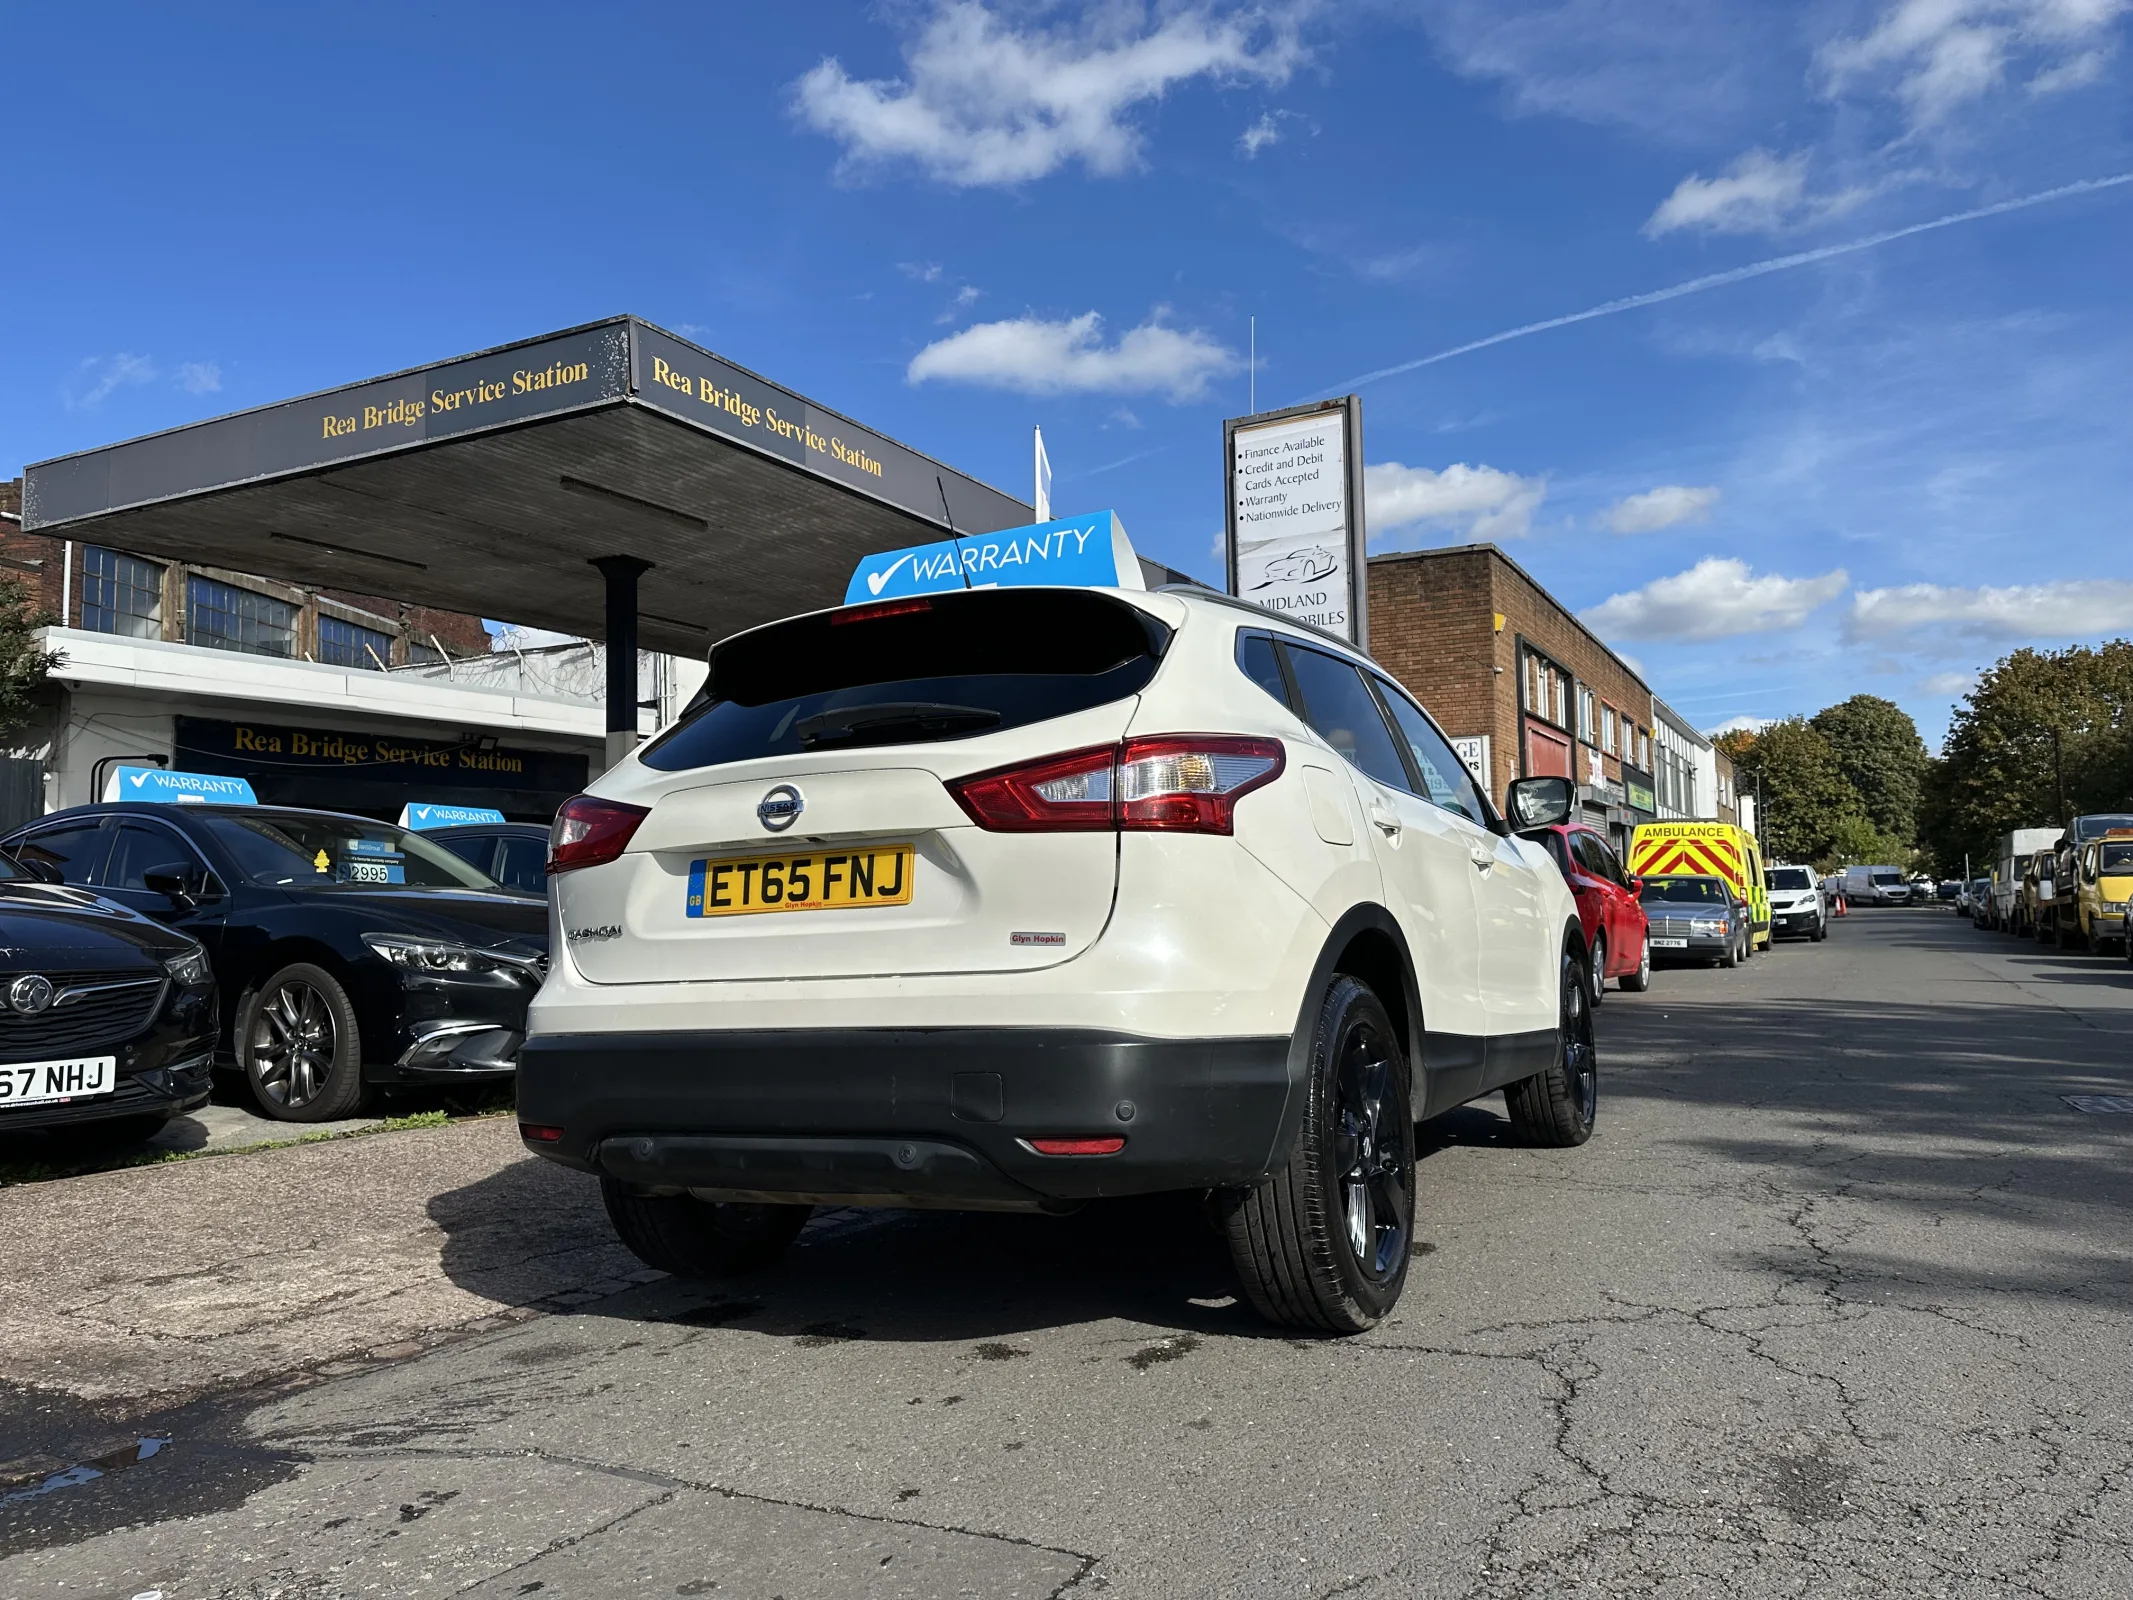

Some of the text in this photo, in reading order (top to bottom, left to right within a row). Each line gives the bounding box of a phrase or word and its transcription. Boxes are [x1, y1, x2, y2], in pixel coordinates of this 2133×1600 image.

[322, 361, 588, 439] Rea Bridge Service Station
[652, 356, 882, 477] Rea Bridge Service Station
[1245, 436, 1325, 459] Finance Available
[1245, 453, 1324, 475] Credit and Debit
[1245, 469, 1319, 491] Cards Accepted
[1245, 493, 1288, 507] Warranty
[1246, 500, 1342, 522] Nationwide Delivery
[912, 525, 1095, 582] WARRANTY
[1259, 592, 1327, 610] MIDLAND
[234, 727, 523, 773] Rea Bridge Service Station
[152, 774, 243, 795] WARRANTY
[433, 808, 498, 823] WARRANTY
[760, 801, 798, 812] NISSAN
[1644, 827, 1725, 838] AMBULANCE
[710, 852, 904, 907] ET65 FNJ
[689, 895, 702, 906] GB
[1012, 935, 1064, 943] Glyn Hopkin
[46, 1062, 103, 1094] NHJ
